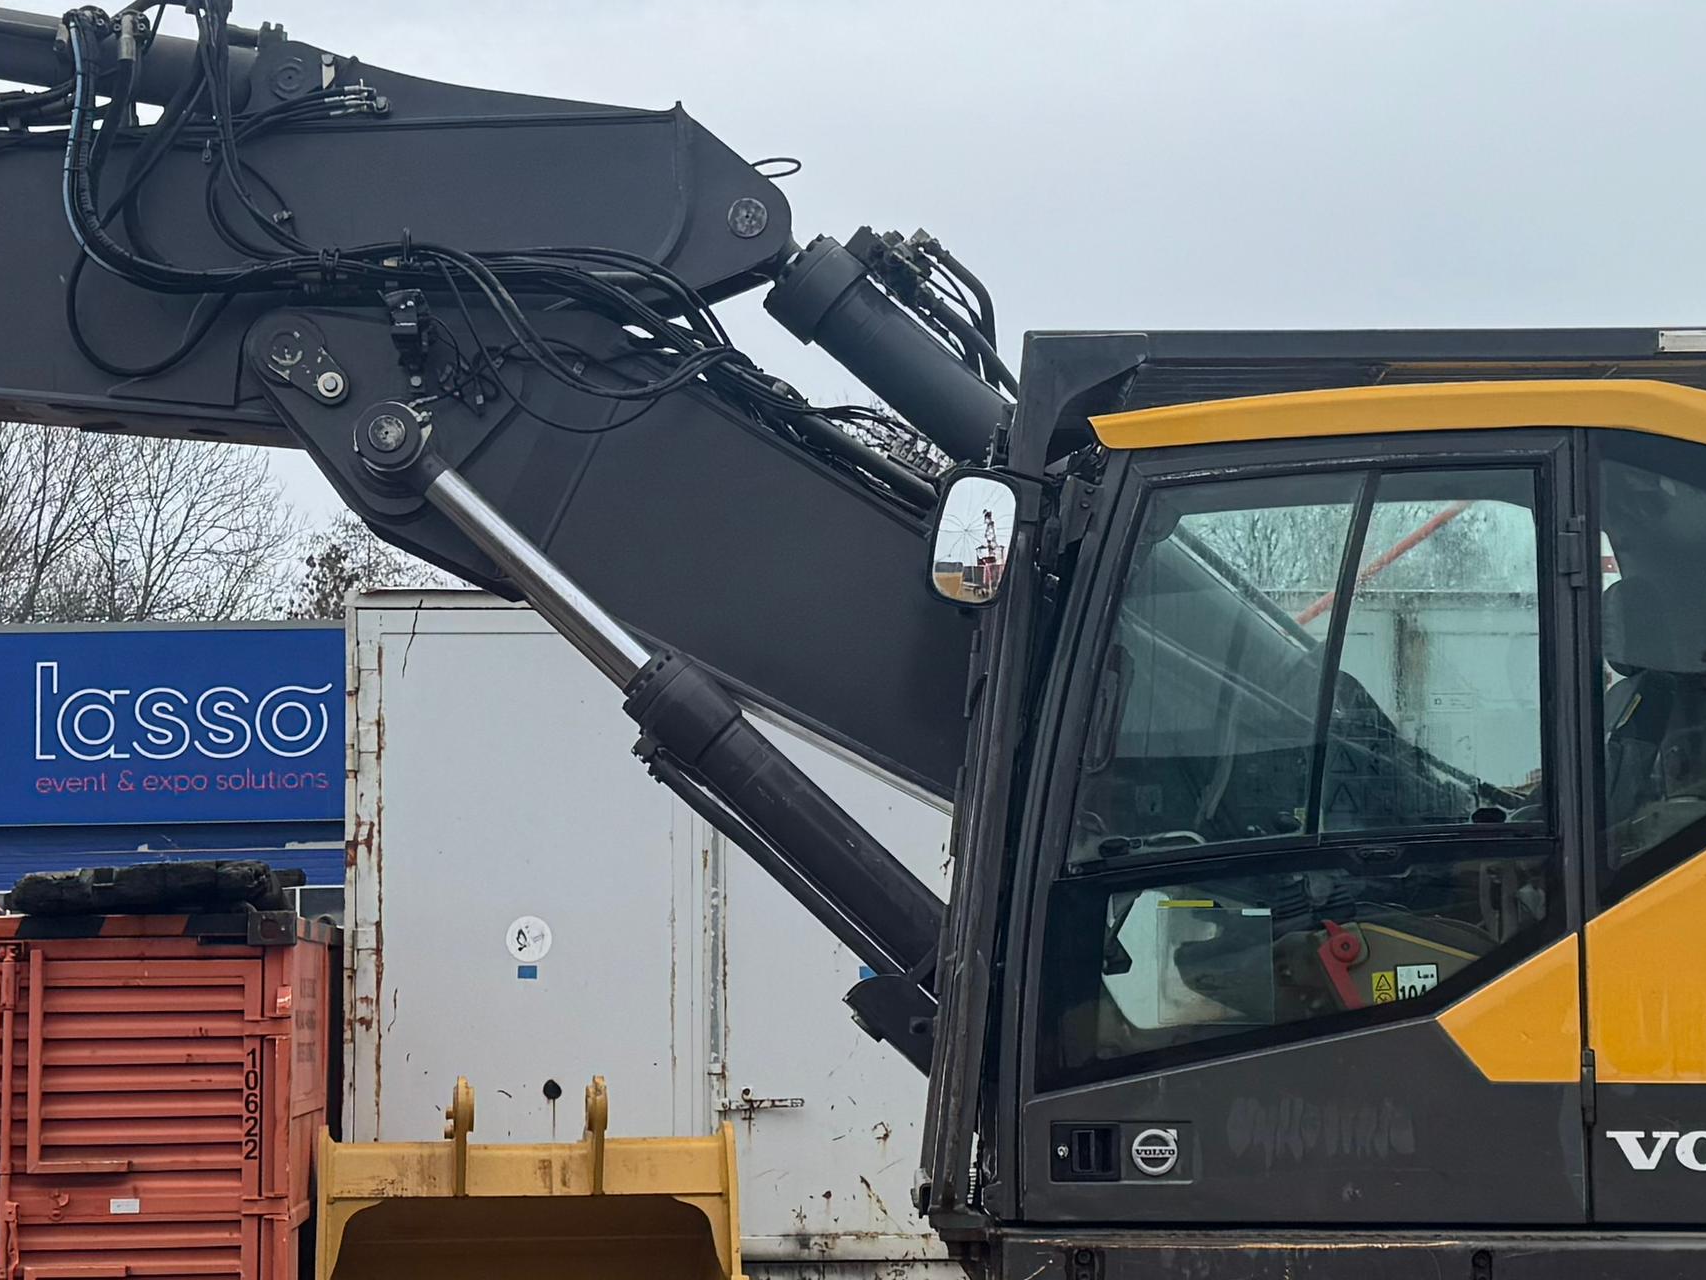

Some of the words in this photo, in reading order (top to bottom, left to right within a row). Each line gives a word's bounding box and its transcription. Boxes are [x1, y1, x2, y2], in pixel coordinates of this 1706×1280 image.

[36, 662, 332, 760] lasso
[36, 771, 107, 794] event
[117, 769, 136, 791] &
[143, 773, 209, 796] expo
[216, 768, 330, 791] solutions
[244, 1047, 259, 1161] 10622
[1135, 1148, 1176, 1156] VOLVO
